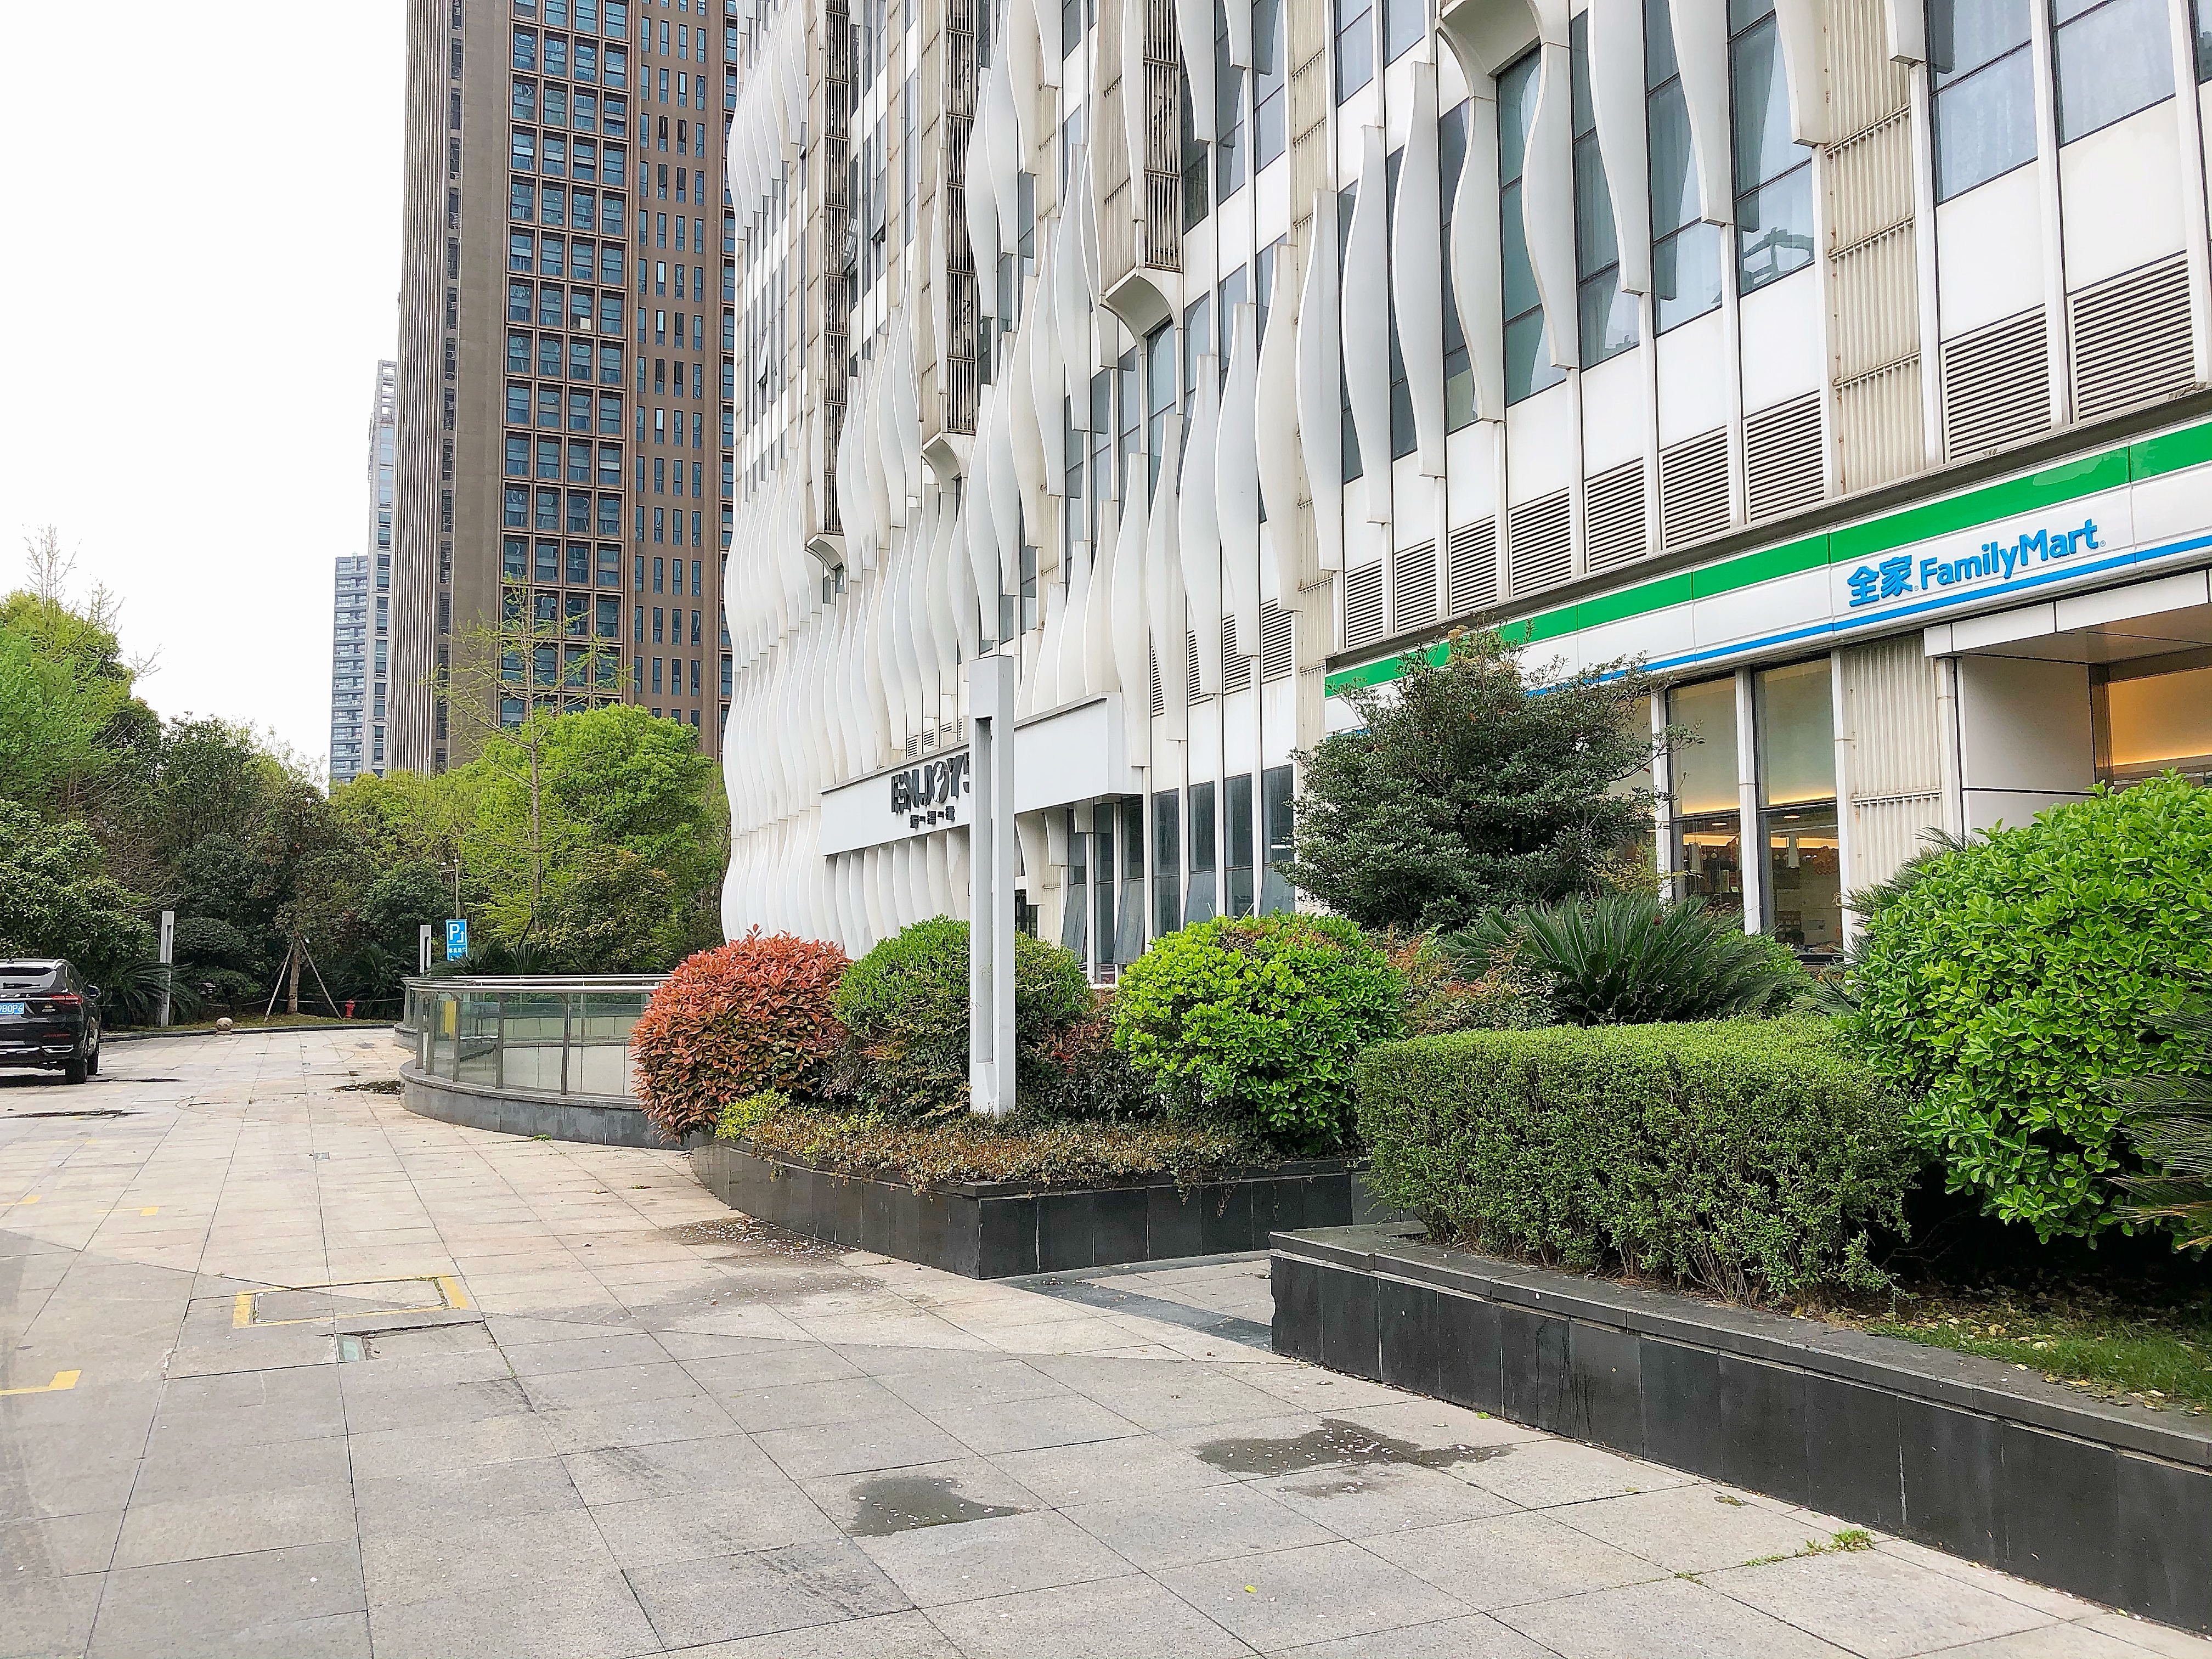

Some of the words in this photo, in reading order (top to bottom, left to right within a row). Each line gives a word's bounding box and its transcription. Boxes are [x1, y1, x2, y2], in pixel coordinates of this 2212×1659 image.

[1847, 555, 1913, 607] 全家
[1920, 518, 2099, 590] FamilyMart
[449, 923, 460, 940] P
